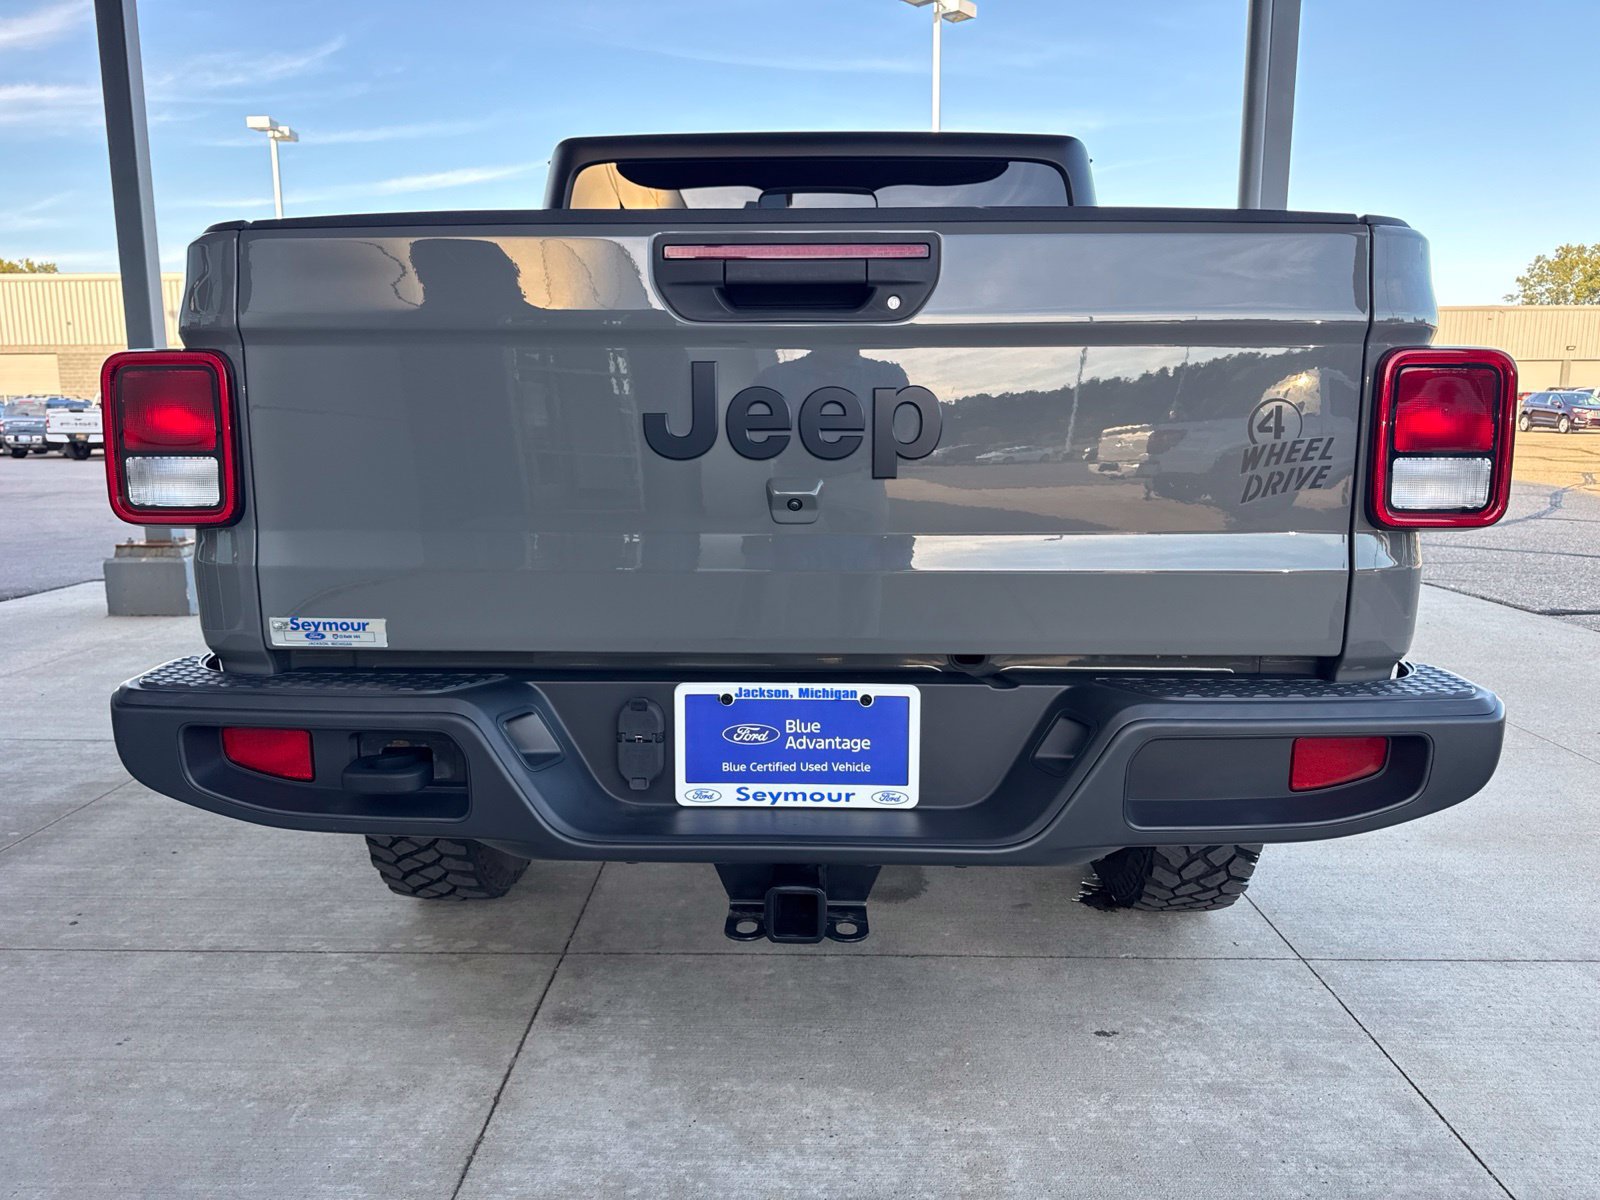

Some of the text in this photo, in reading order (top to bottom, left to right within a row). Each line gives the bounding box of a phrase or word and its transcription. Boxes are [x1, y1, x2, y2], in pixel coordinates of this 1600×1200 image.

[643, 360, 943, 479] Jeep
[1257, 405, 1285, 439] 4
[1240, 437, 1335, 475] WHEEL
[1240, 465, 1332, 504] DRIVE
[289, 616, 370, 633] Seymour
[735, 687, 858, 700] Jackson, Michigan
[785, 719, 821, 733] Blue
[785, 735, 871, 752] Advantage
[722, 761, 871, 772] Blue Certified Used Vehicle
[736, 786, 855, 806] Seymour
